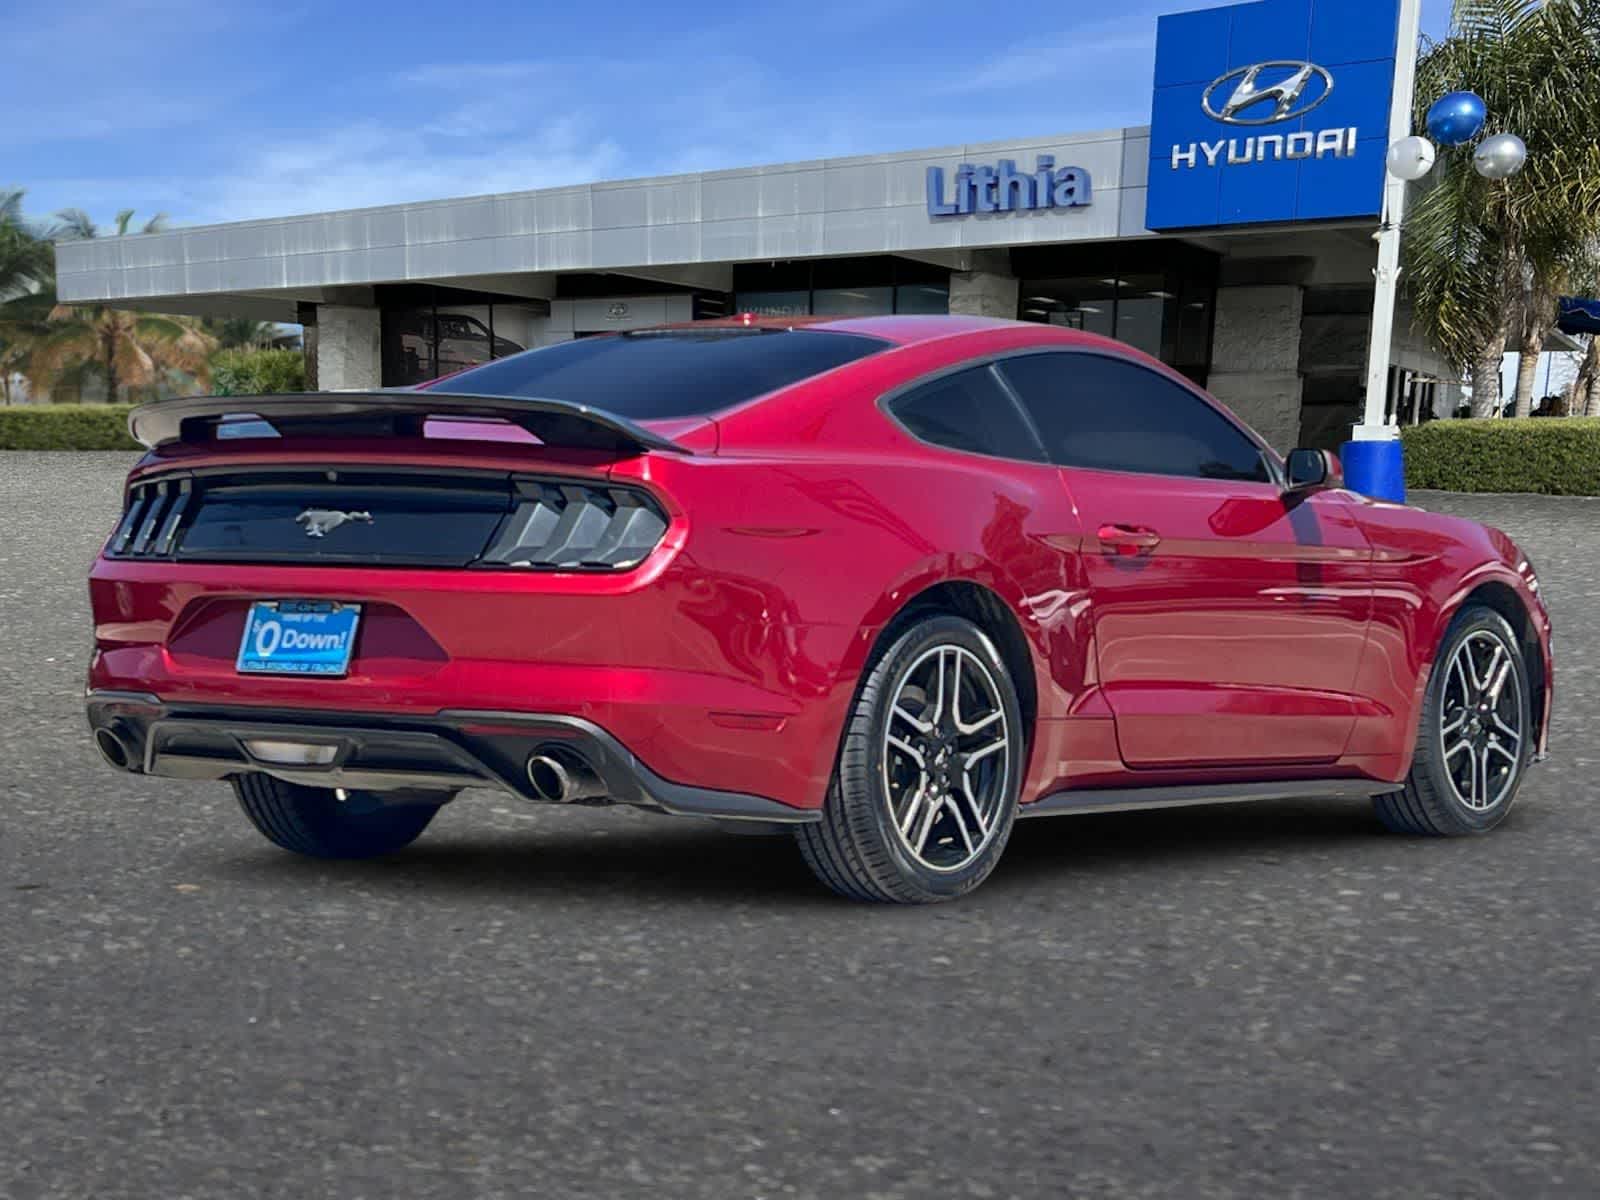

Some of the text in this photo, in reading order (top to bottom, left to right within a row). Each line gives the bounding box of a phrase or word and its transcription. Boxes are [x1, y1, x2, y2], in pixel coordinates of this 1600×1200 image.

[1171, 127, 1358, 169] HYUNDAI
[926, 154, 1092, 216] Lithia
[281, 628, 347, 649] Down!
